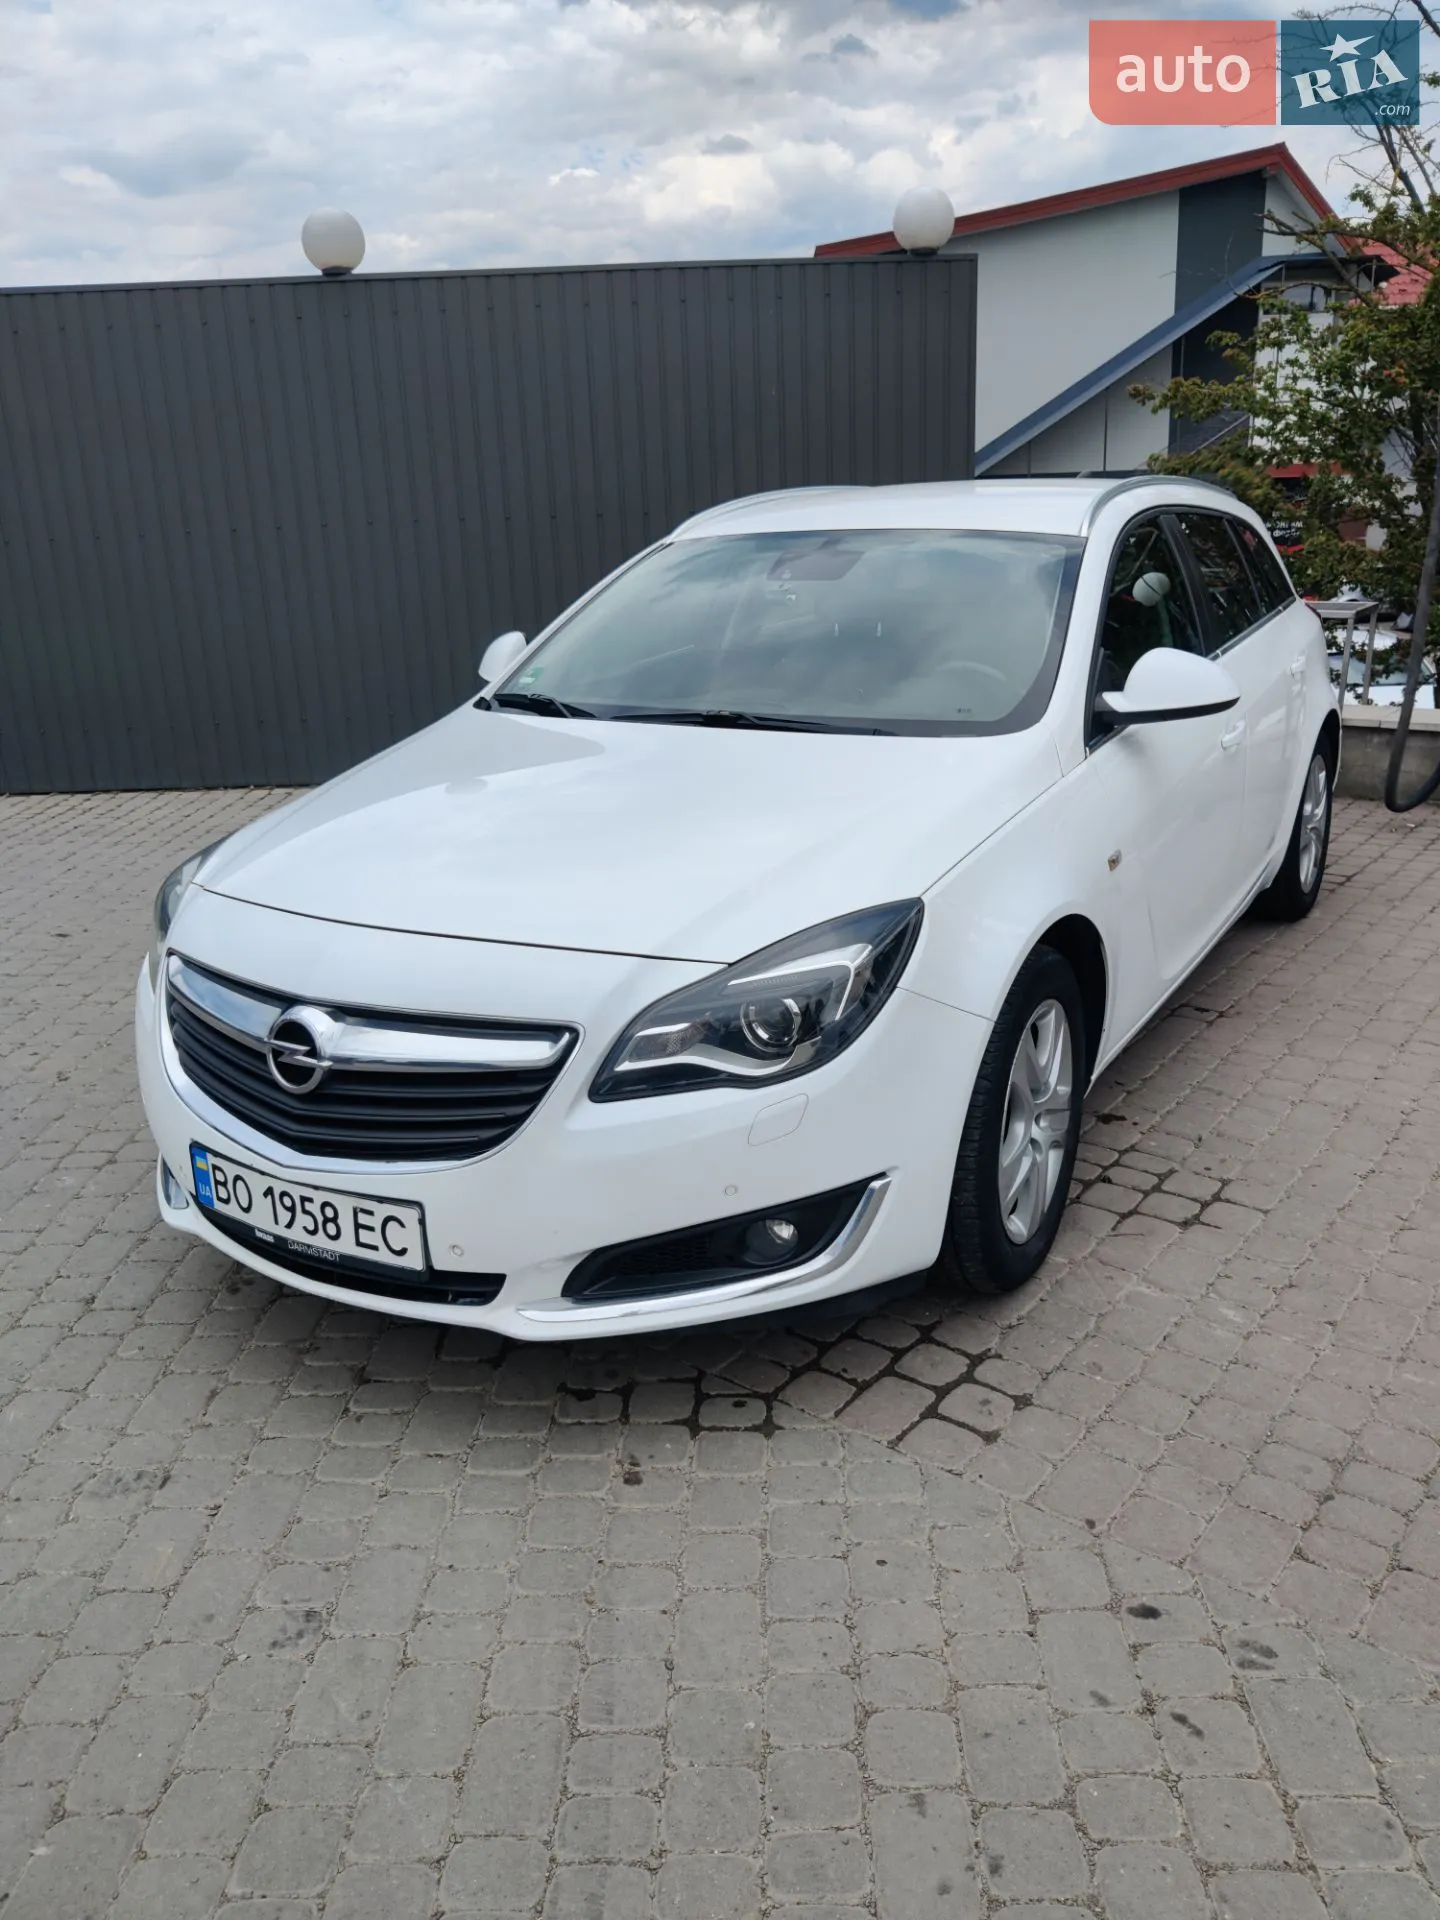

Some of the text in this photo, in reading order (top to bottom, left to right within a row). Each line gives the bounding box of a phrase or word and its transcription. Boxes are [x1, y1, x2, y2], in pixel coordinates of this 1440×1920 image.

[199, 1181, 212, 1198] UA
[211, 1163, 409, 1257] BO 1958 EC
[287, 1240, 341, 1263] DARMSTADT
